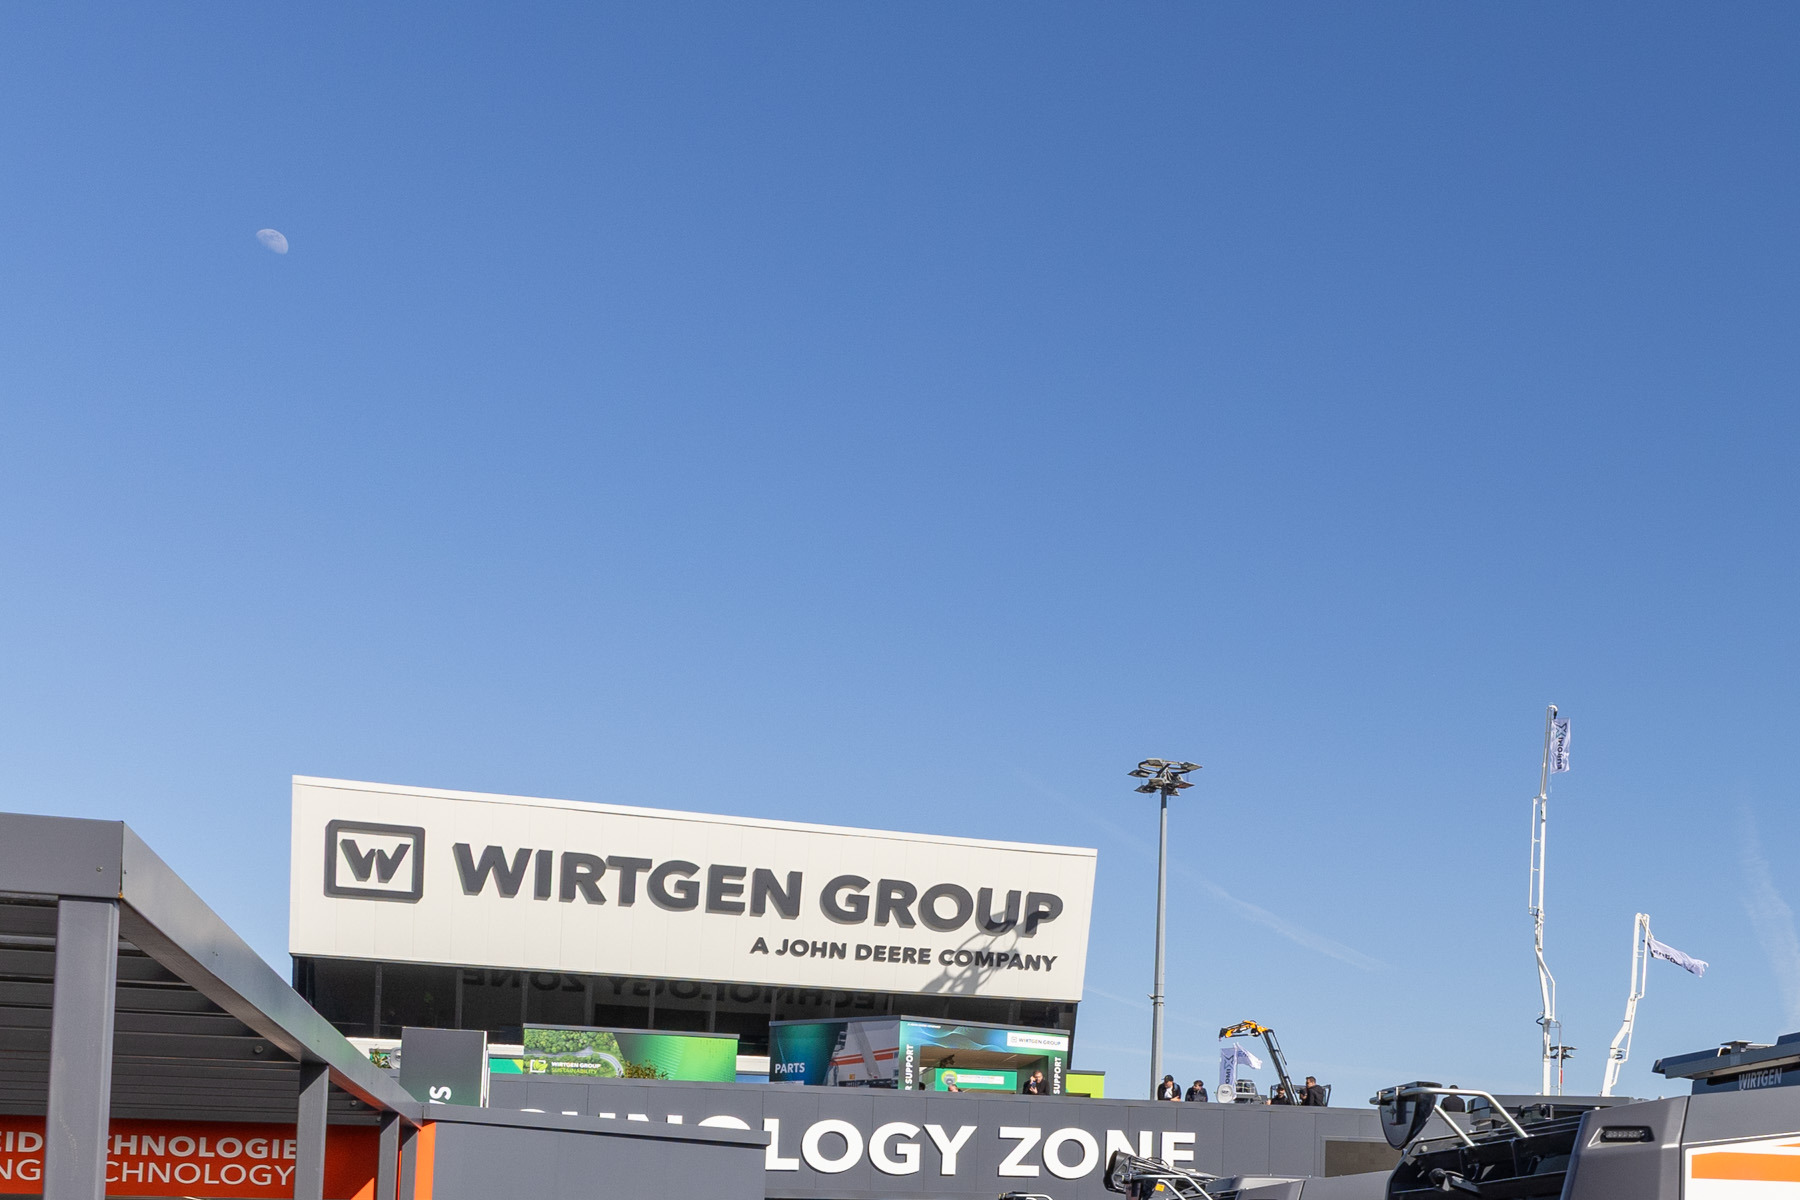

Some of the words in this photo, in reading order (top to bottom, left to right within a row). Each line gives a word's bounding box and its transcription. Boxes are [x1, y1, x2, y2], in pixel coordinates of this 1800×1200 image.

[452, 842, 803, 920] WIRTGEN
[820, 875, 1063, 938] GROUP
[750, 936, 769, 954] A
[775, 939, 847, 960] JOHN
[855, 943, 931, 965] DEERE
[939, 949, 1058, 972] COMPANY
[774, 1062, 805, 1073] PARTS
[905, 1044, 914, 1084] SUPPORT
[1053, 1057, 1061, 1095] SUPPORT
[1738, 1067, 1783, 1091] WIRTGEN
[105, 1161, 295, 1186] CHNOLOGY
